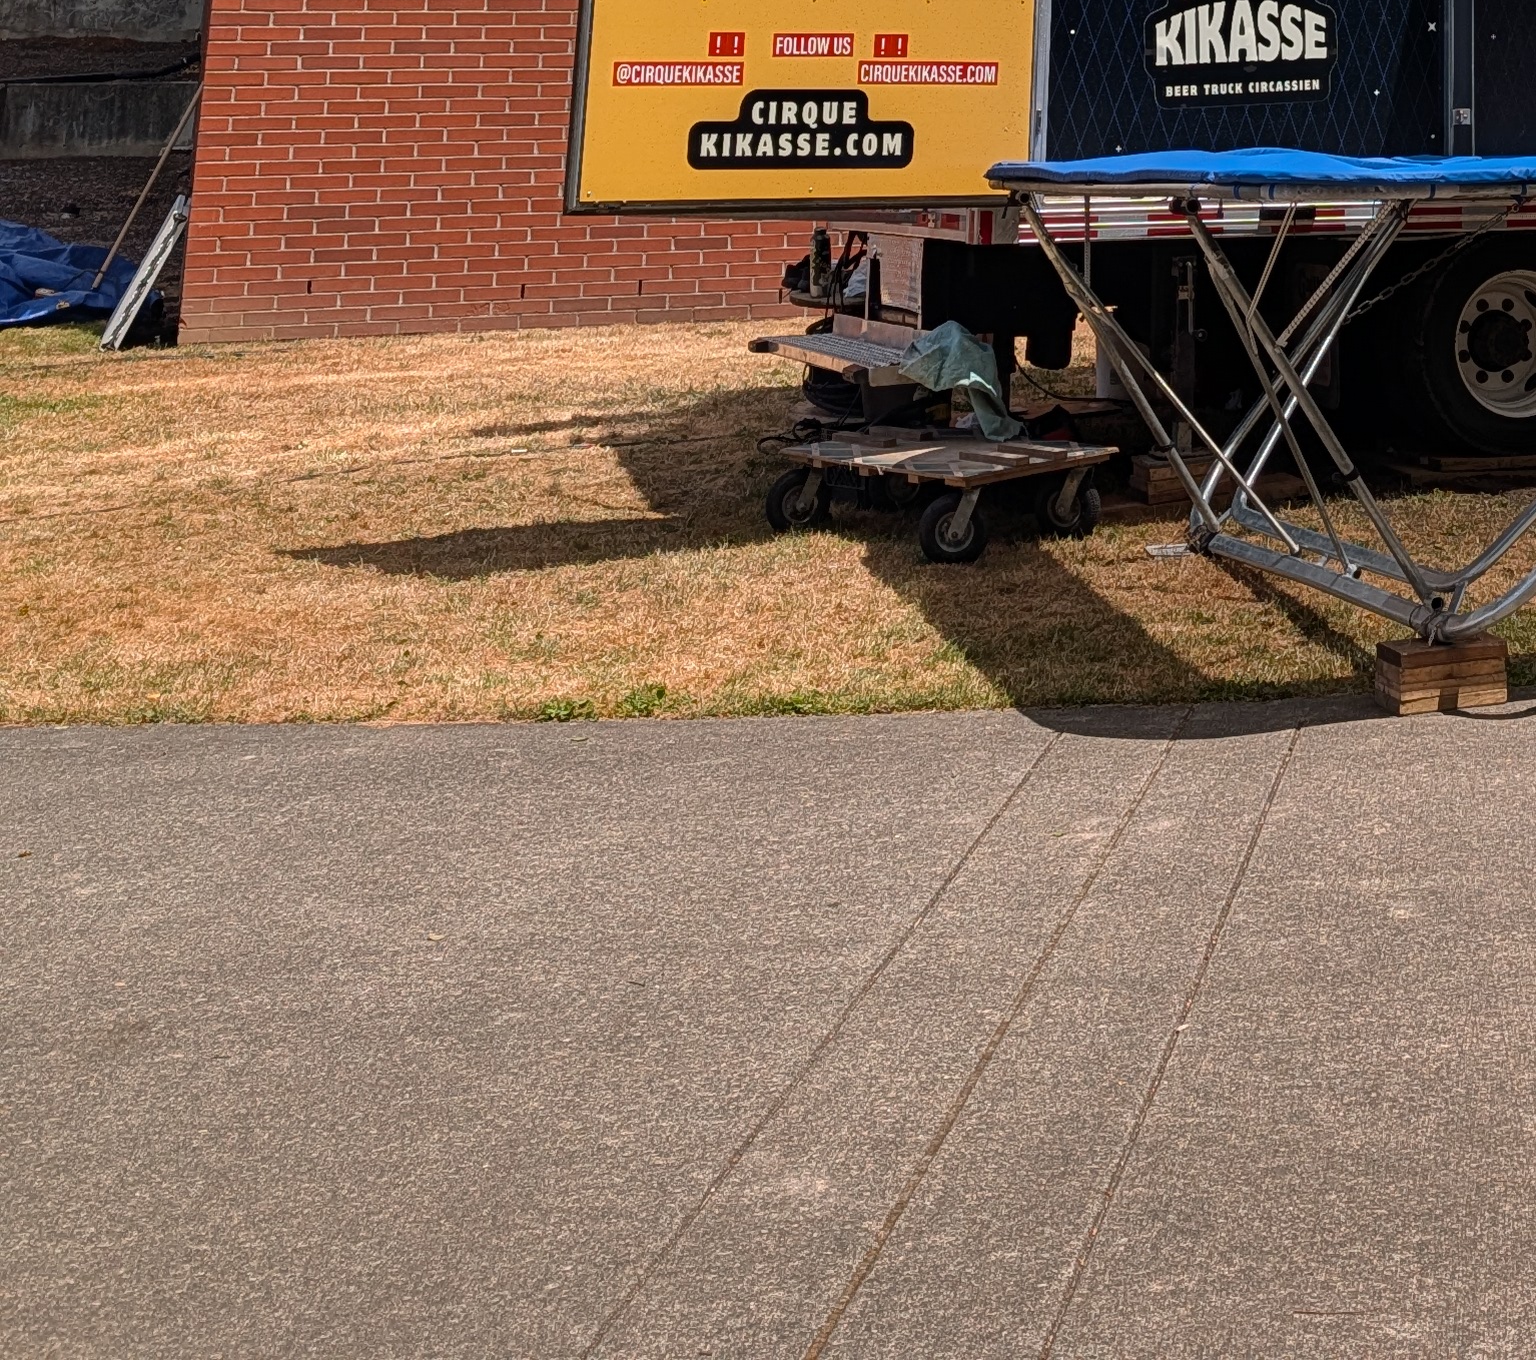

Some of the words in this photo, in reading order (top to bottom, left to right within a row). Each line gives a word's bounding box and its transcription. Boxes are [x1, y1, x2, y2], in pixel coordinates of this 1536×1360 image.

[1155, 0, 1328, 66] KIKASSE
[775, 37, 829, 55] FOLLOW
[833, 37, 852, 55] US
[616, 64, 741, 84] @CIRQUEKIKASSE
[860, 64, 996, 84] CIRQUEKIKASSE.COM
[1165, 85, 1198, 97] BEER
[1203, 83, 1243, 95] TRUCK
[1248, 79, 1320, 92] CIRCASSIEN
[751, 101, 859, 129] CIRQUE
[699, 132, 904, 158] KIKASSE.COM
